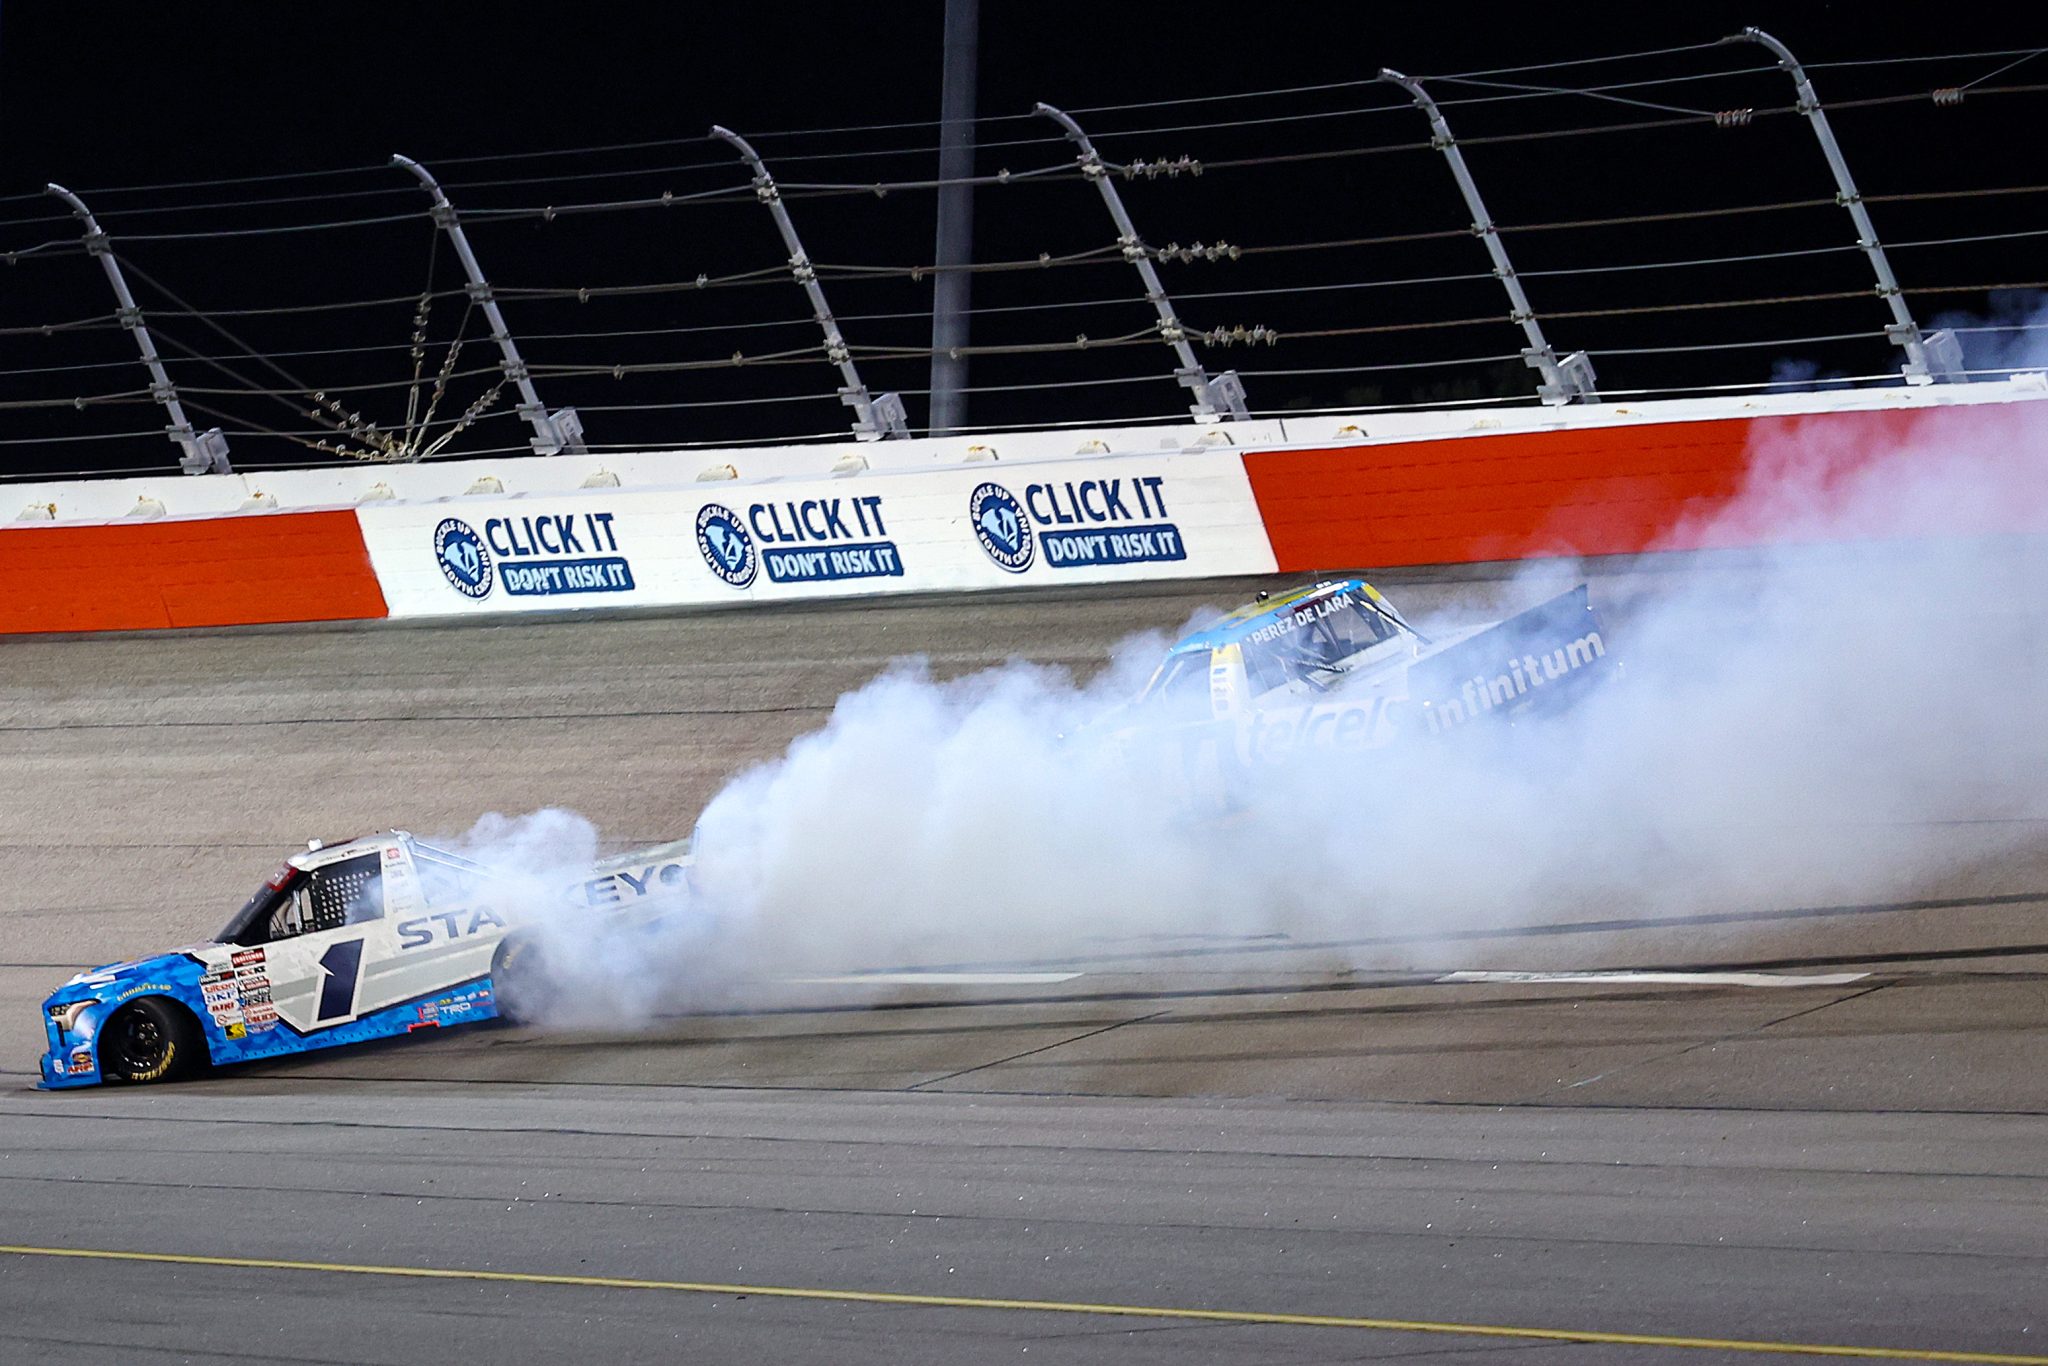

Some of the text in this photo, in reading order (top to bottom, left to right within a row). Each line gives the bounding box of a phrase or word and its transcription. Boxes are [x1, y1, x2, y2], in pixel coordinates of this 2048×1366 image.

[995, 486, 1010, 501] UP
[1025, 476, 1168, 525] CLICK IT
[457, 521, 471, 536] UP
[485, 512, 618, 557] CLICK IT
[730, 516, 745, 534] UP
[749, 496, 887, 543] CLICK IT
[698, 535, 726, 578] SOUTH
[769, 548, 896, 578] DON'T RISK IT
[979, 531, 1013, 566] SOUTH
[1046, 531, 1177, 562] DON'T RISK IT
[443, 563, 475, 596] SOUTH
[504, 563, 627, 592] DON'T RISK IT
[1251, 592, 1354, 645] PEREZ DE LARA
[1424, 631, 1606, 734] infinitum
[315, 936, 366, 1022] 1
